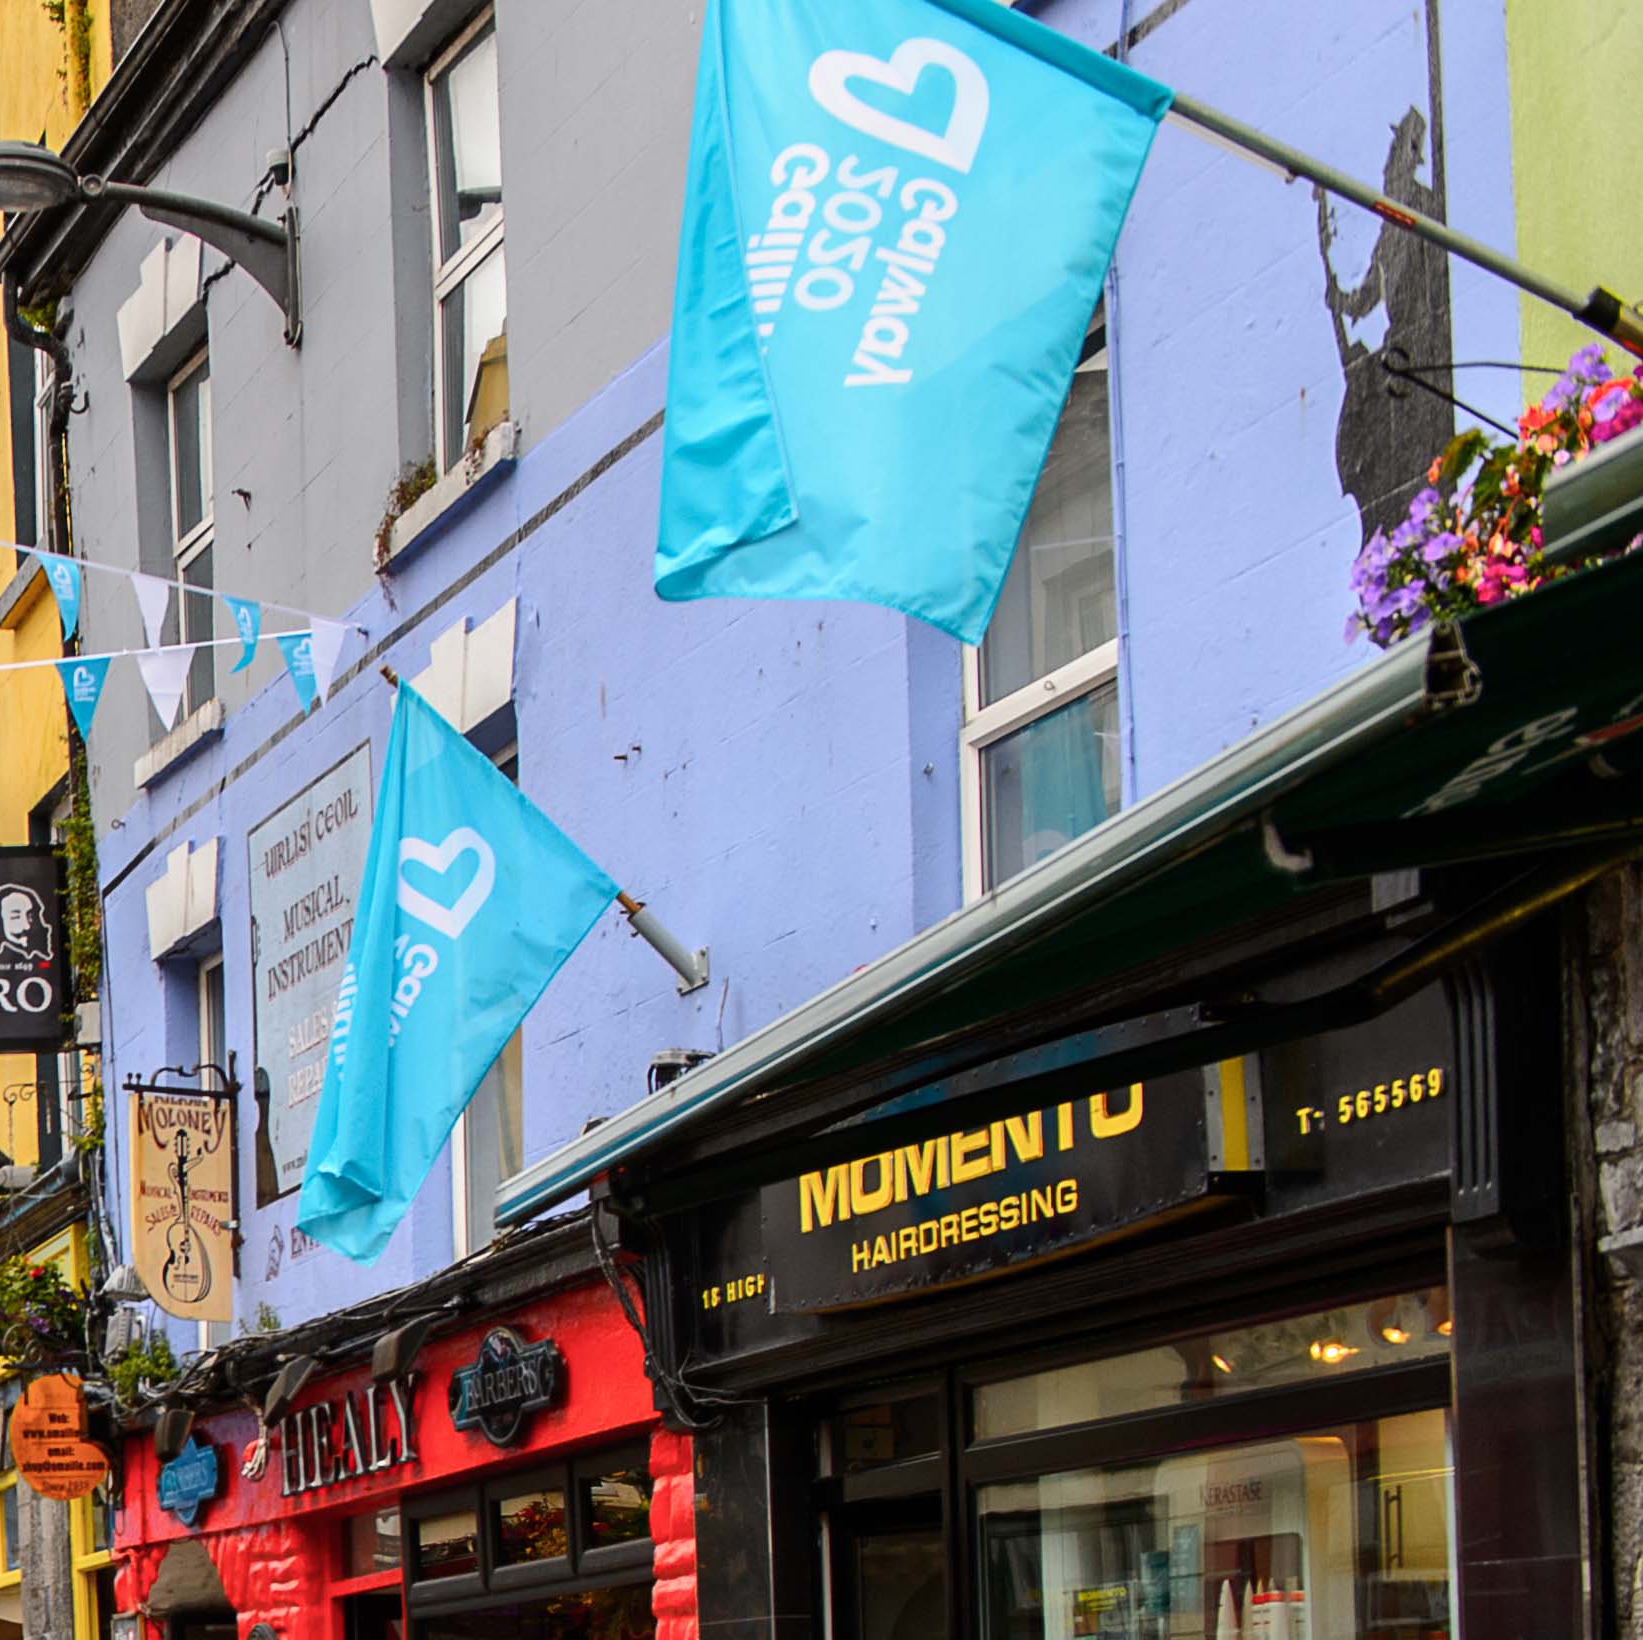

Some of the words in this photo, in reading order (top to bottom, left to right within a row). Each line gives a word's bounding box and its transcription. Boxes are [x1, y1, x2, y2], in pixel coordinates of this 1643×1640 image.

[283, 874, 349, 943] MUSICAL
[268, 918, 354, 1000] INSTRUMENT
[138, 1101, 227, 1152] MOLONEY
[1338, 1067, 1443, 1124] 565569
[851, 1178, 1078, 1273] HAIRDRESSING
[279, 1372, 419, 1497] HEALY
